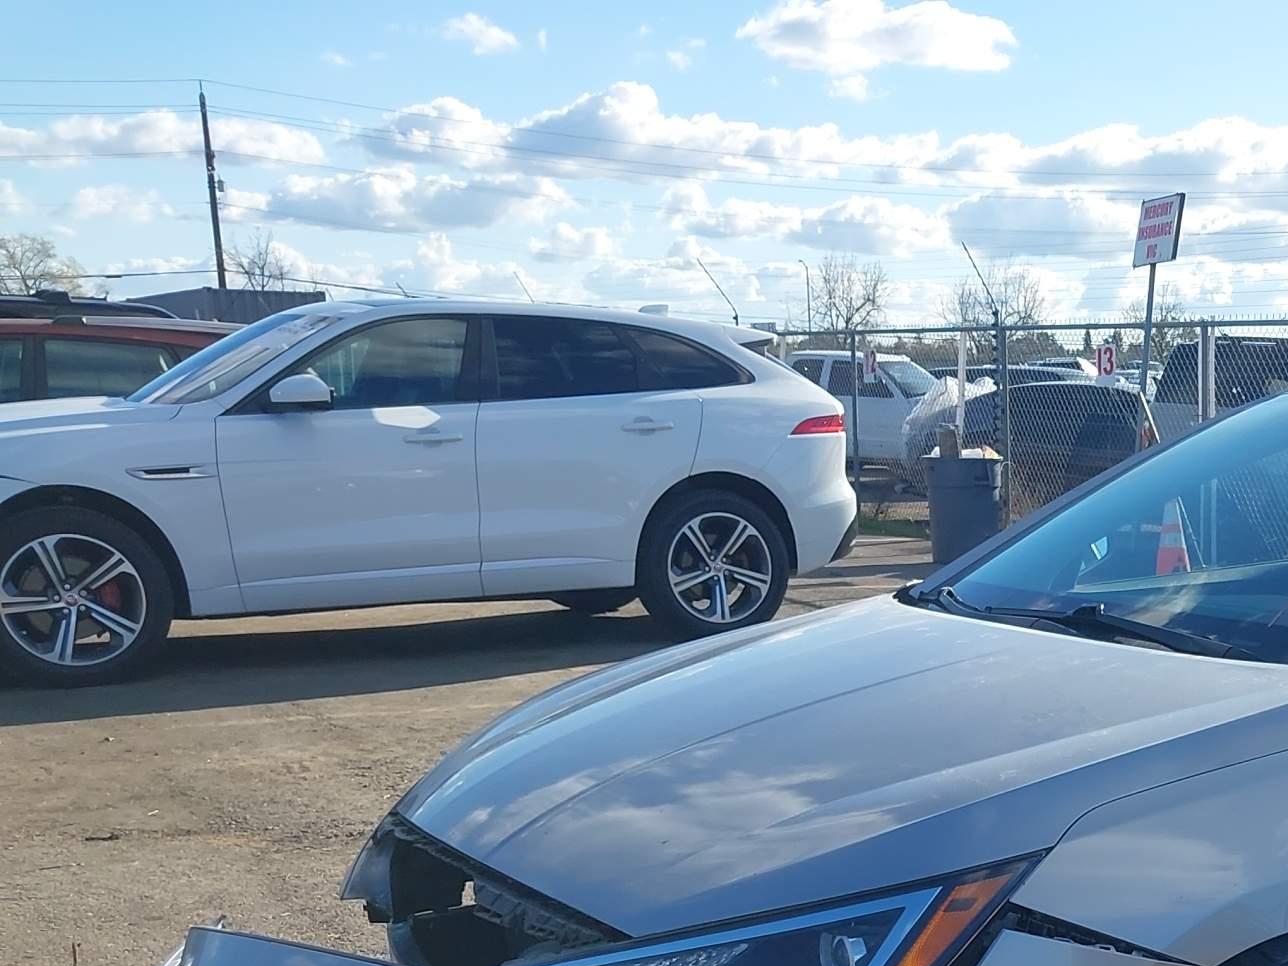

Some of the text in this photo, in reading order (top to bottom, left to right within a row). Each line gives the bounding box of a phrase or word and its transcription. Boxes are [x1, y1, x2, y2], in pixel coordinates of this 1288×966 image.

[1143, 201, 1173, 220] MERCURY
[1137, 221, 1173, 241] INSURANCE
[1097, 346, 1114, 376] 13
